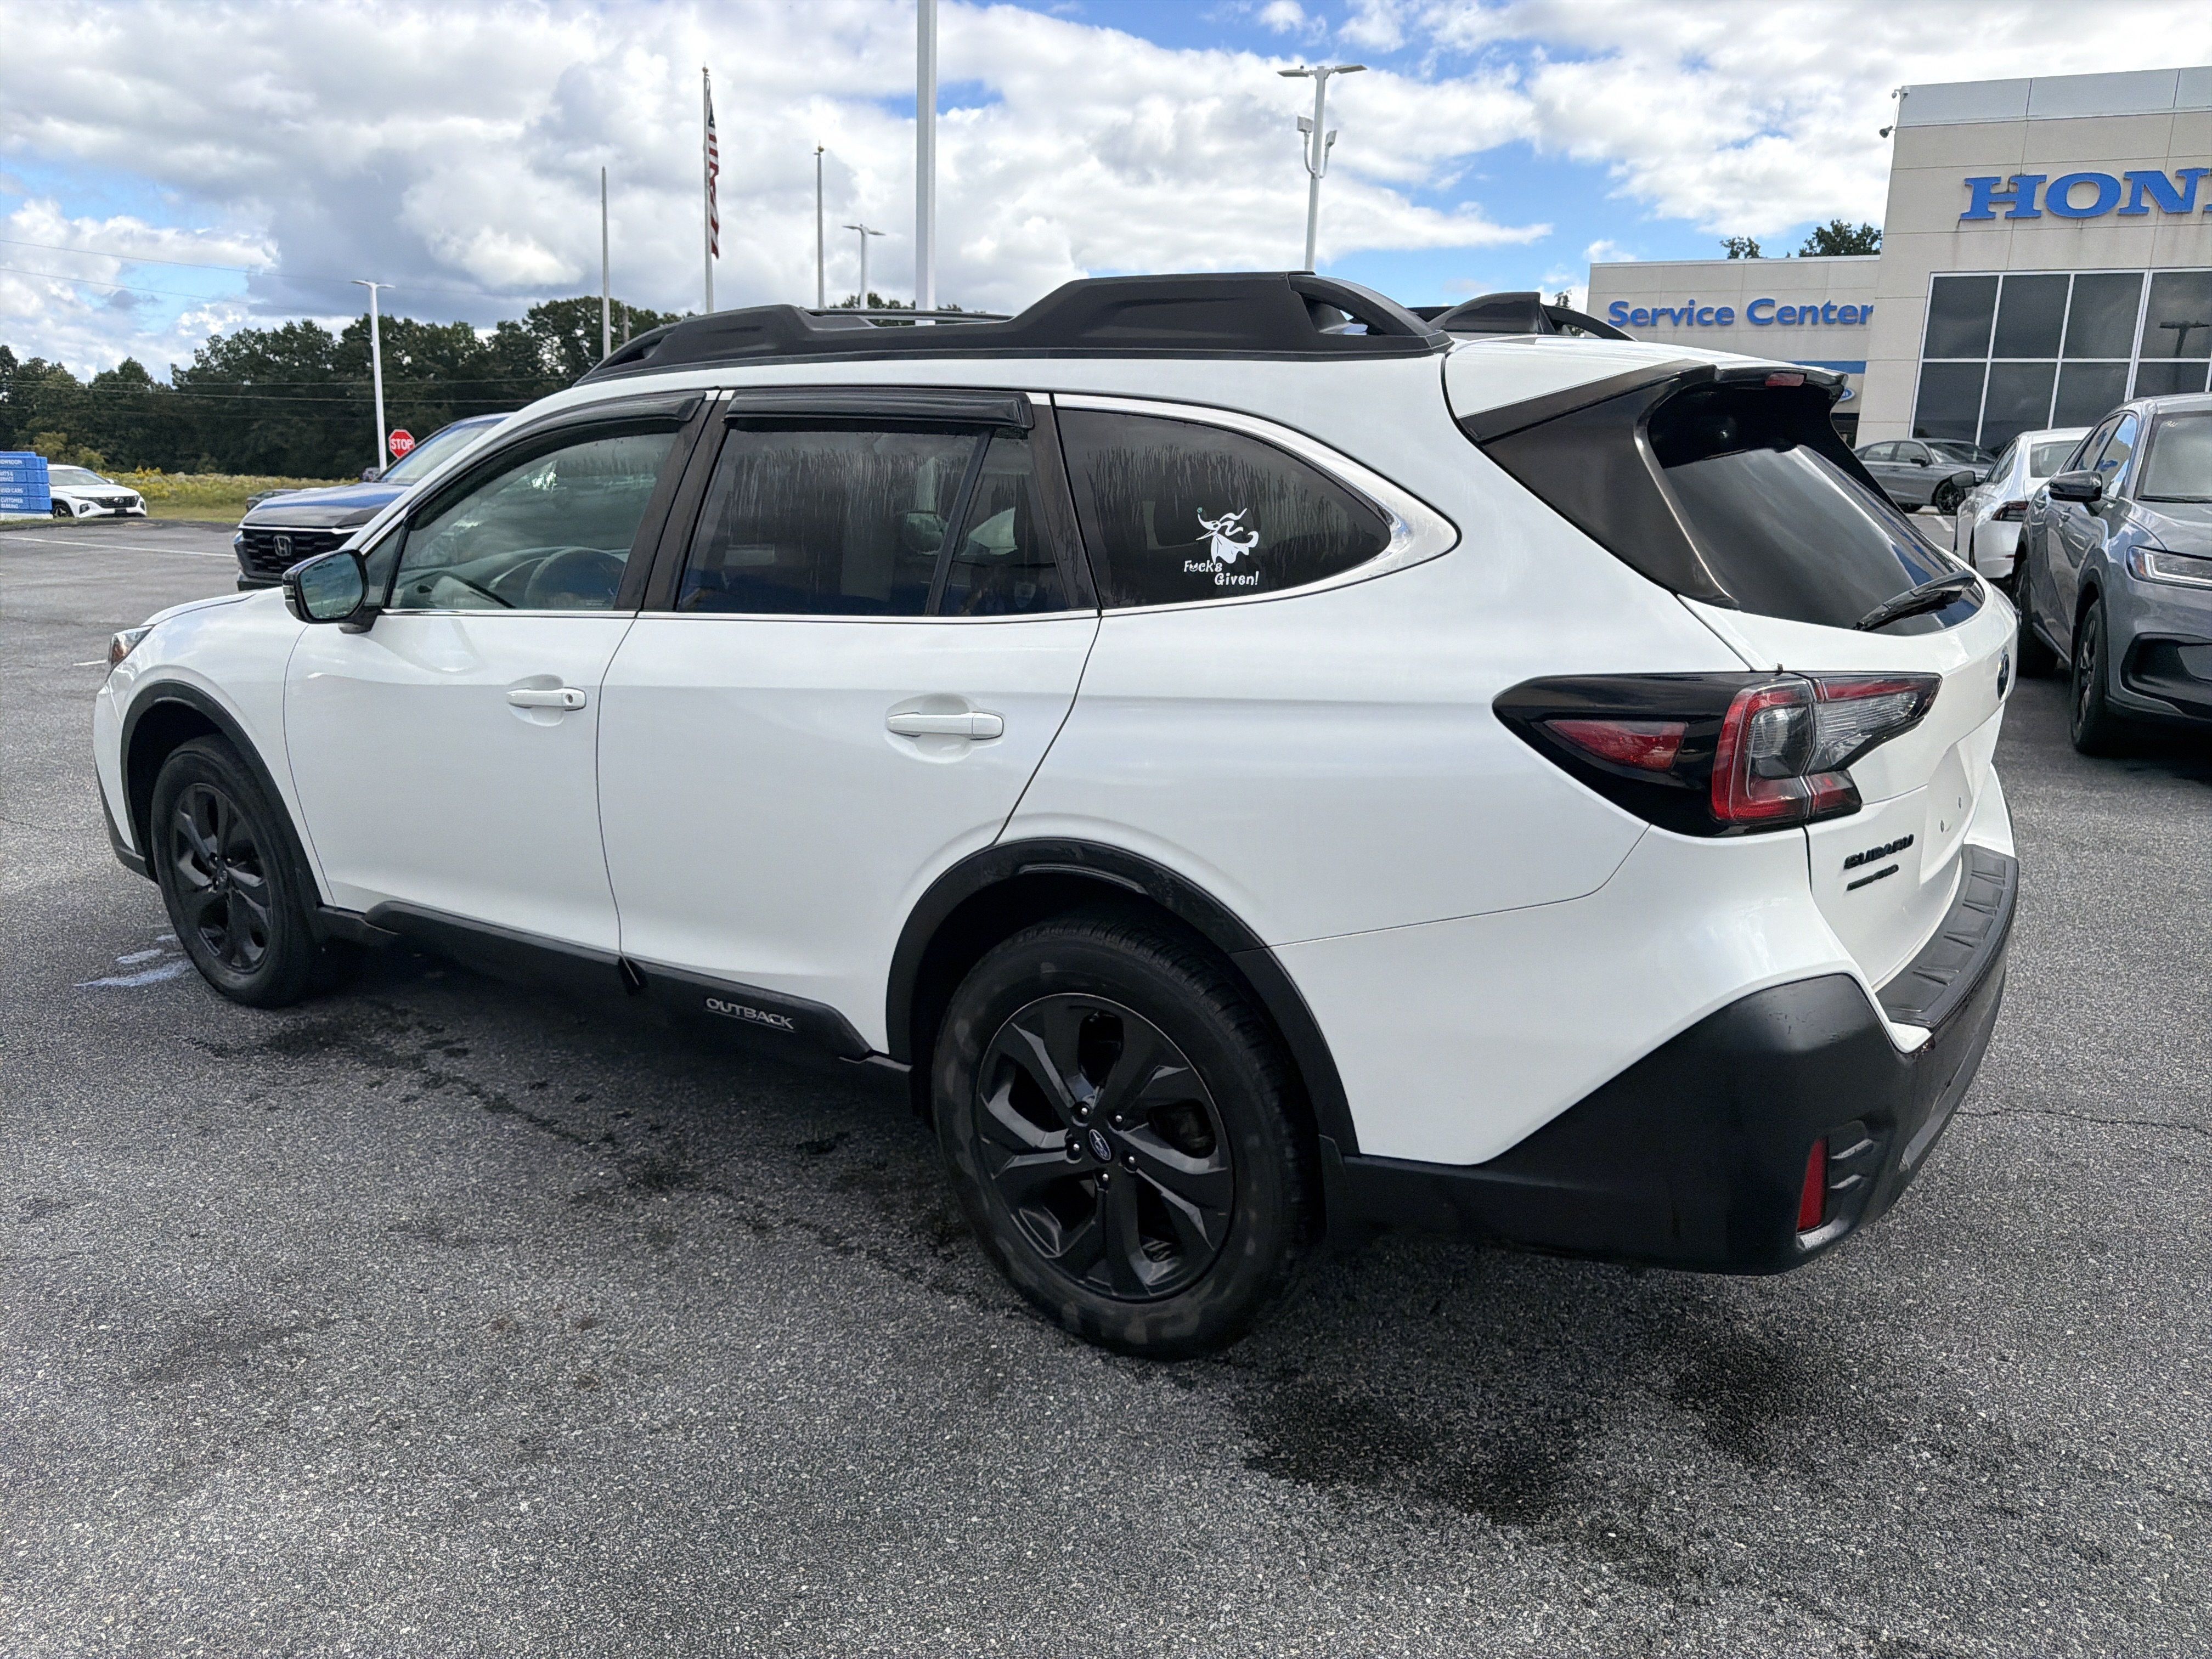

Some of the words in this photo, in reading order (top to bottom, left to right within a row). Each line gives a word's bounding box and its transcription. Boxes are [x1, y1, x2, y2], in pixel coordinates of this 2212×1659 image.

[1960, 168, 2212, 219] HON
[1608, 299, 1735, 327] Service
[1746, 298, 1874, 325] Center
[390, 438, 413, 450] STOP
[1214, 571, 1260, 585] Given!
[1844, 834, 1914, 870] SUBARU
[706, 998, 794, 1029] OUTBACK
